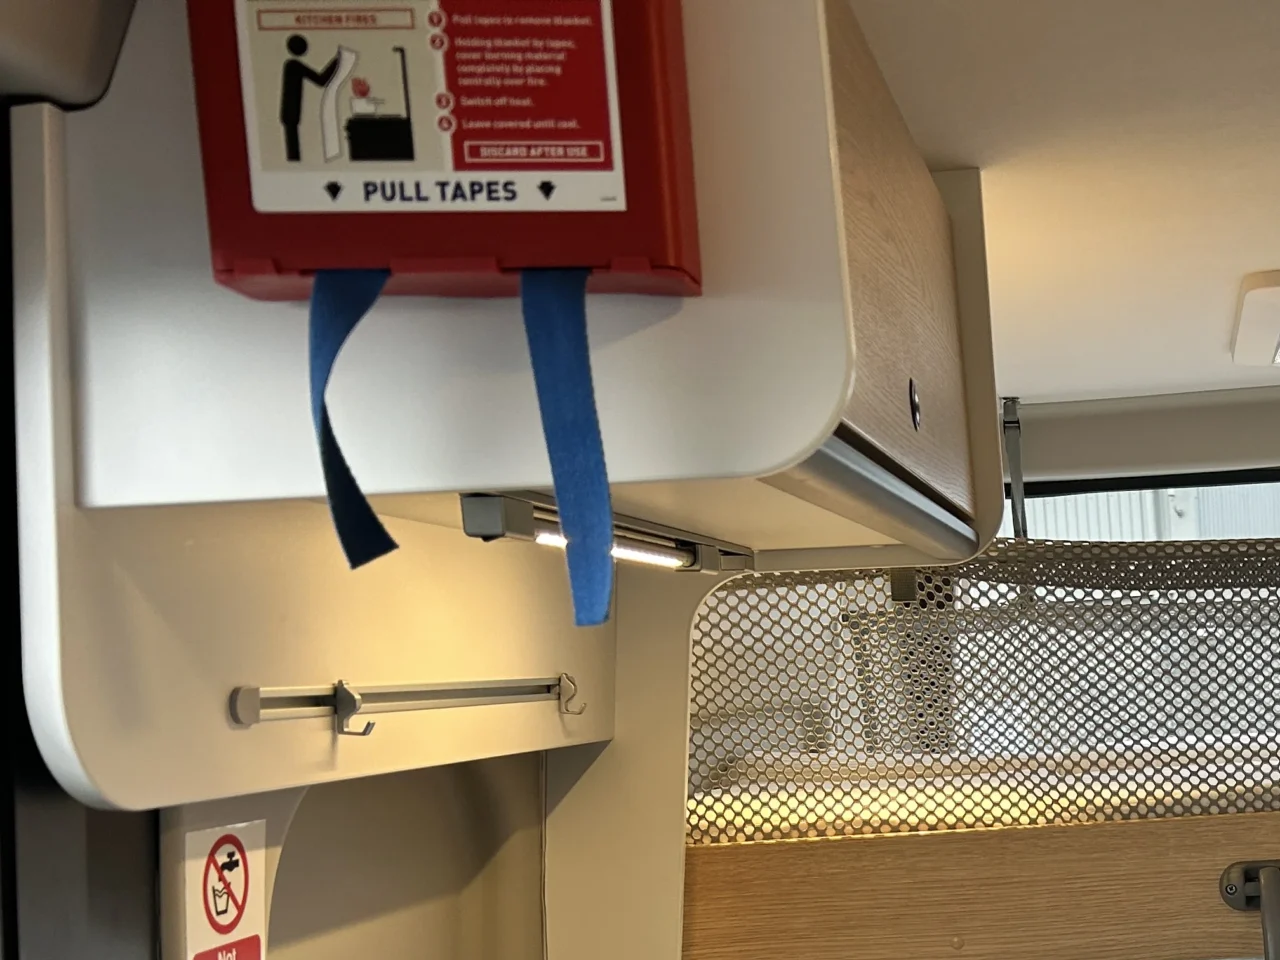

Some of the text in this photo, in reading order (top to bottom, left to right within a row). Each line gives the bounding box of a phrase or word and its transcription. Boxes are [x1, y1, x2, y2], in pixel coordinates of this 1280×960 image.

[479, 146, 528, 158] DISCARD
[530, 146, 565, 158] AFTER
[363, 180, 518, 202] PULL TAPES
